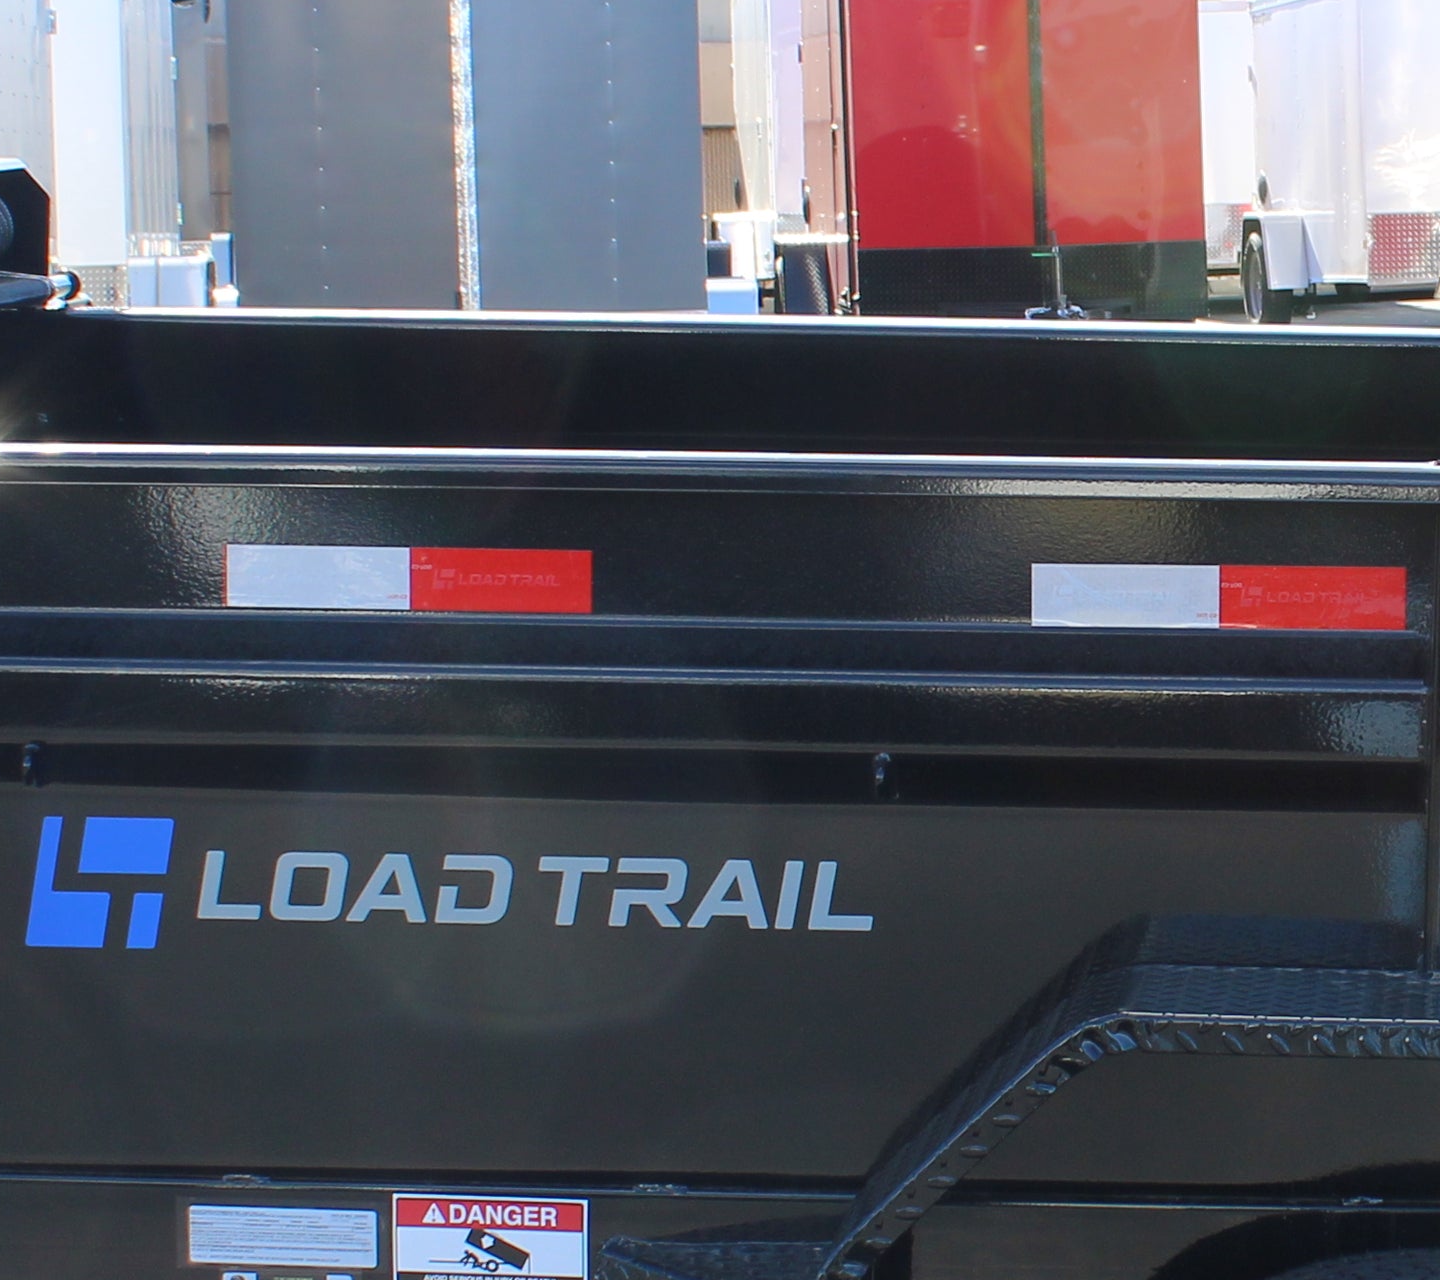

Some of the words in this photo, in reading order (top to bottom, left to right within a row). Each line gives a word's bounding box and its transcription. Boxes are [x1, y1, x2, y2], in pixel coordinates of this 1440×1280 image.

[195, 849, 515, 925] LOAD
[538, 854, 874, 932] TRAIL
[449, 1203, 557, 1227] DANGER
